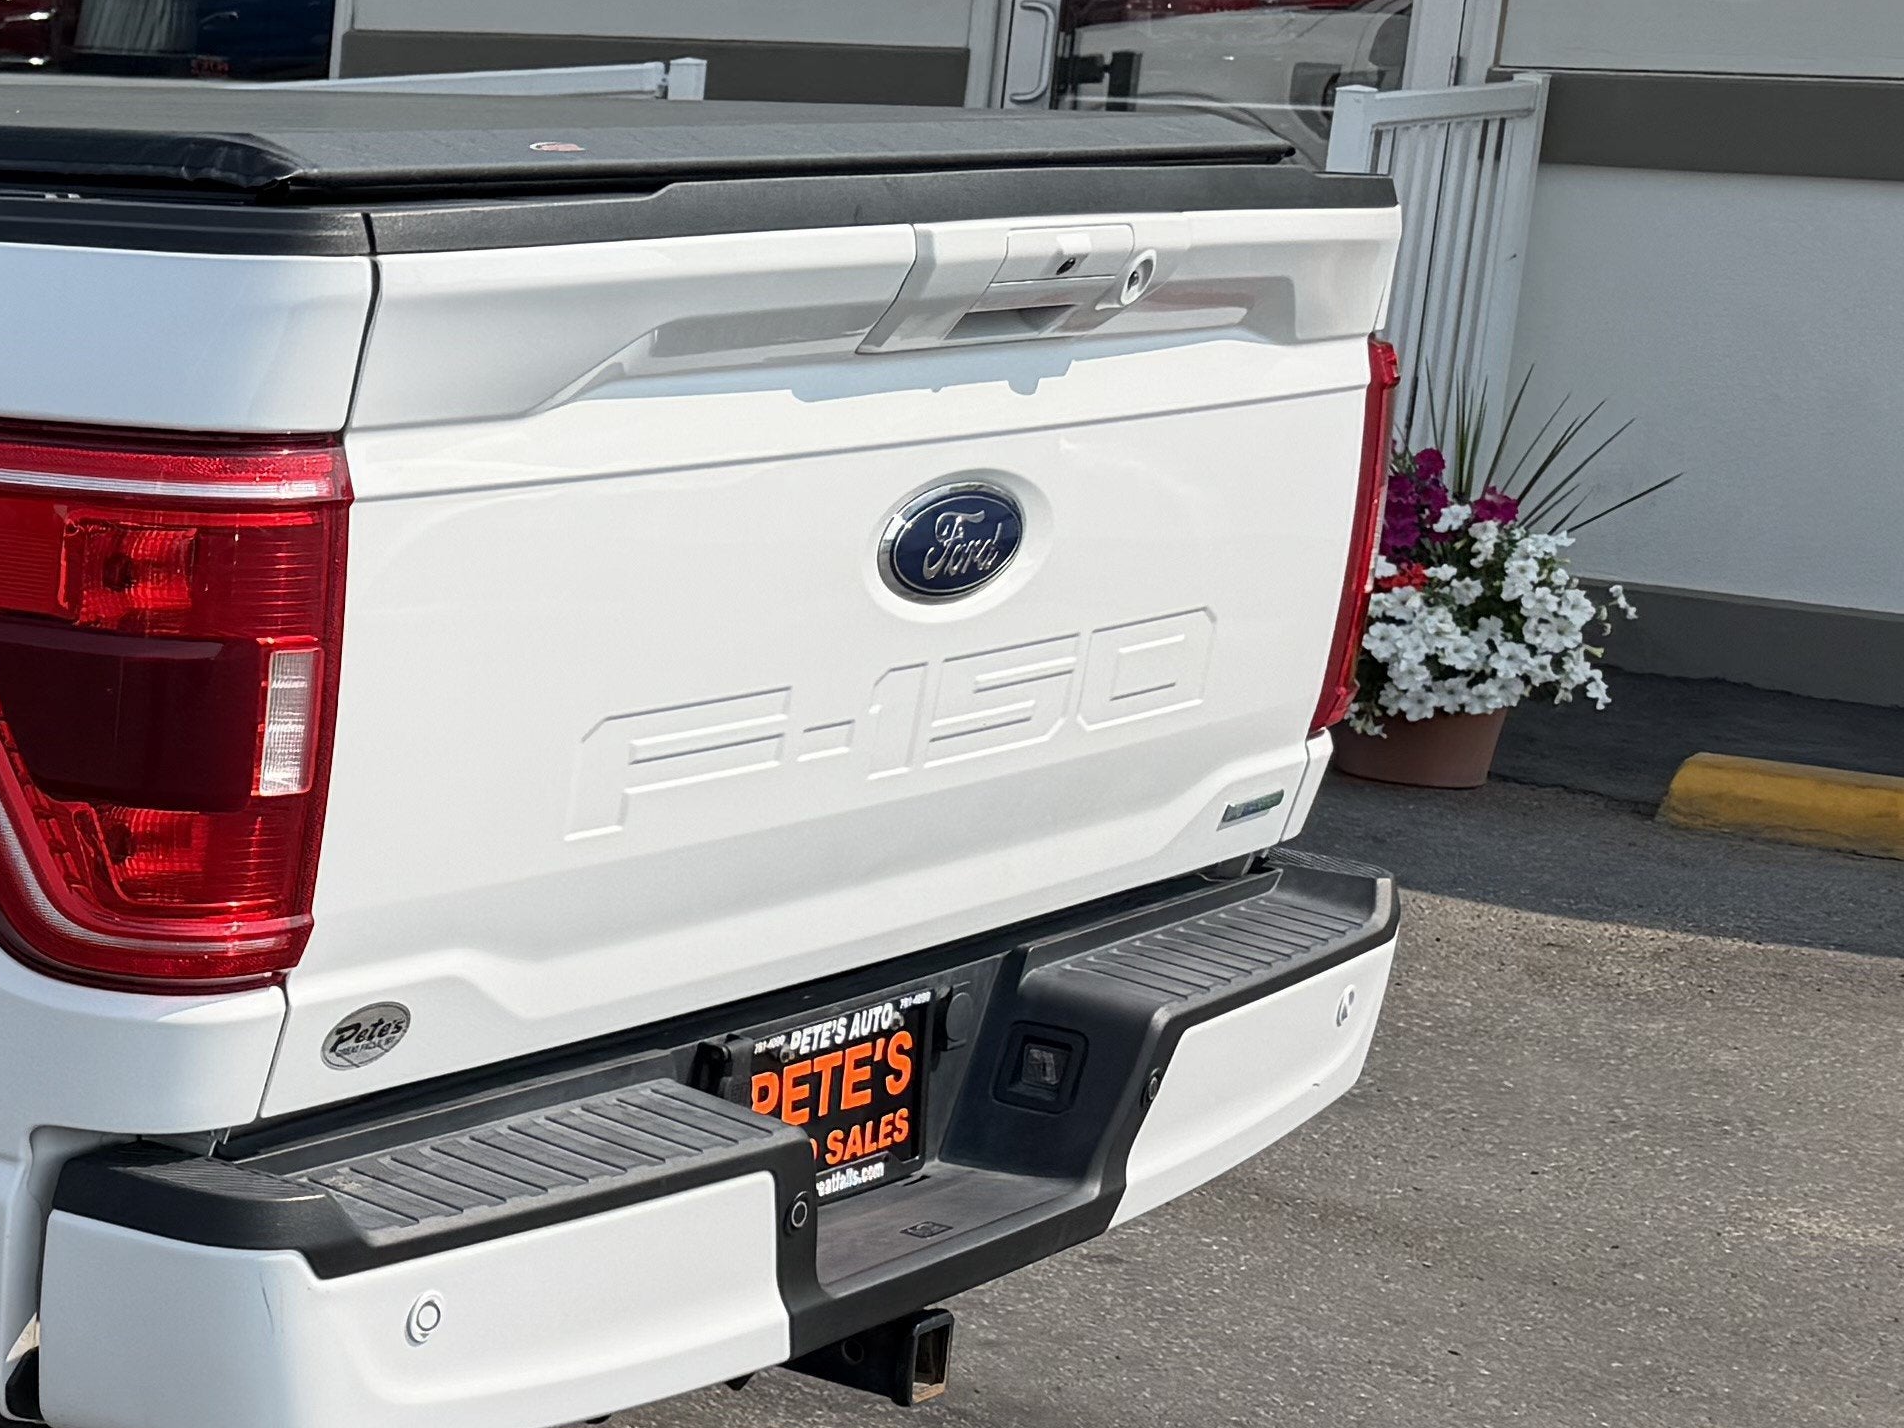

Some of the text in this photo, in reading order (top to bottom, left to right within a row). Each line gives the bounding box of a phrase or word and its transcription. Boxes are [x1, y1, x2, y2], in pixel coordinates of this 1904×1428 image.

[922, 509, 1003, 581] Ford
[565, 605, 1217, 841] F-150
[329, 1017, 406, 1054] Pete's
[790, 1002, 894, 1056] PETE'S AUTO
[751, 1030, 914, 1127] PETE'S
[824, 1107, 910, 1166] SALES
